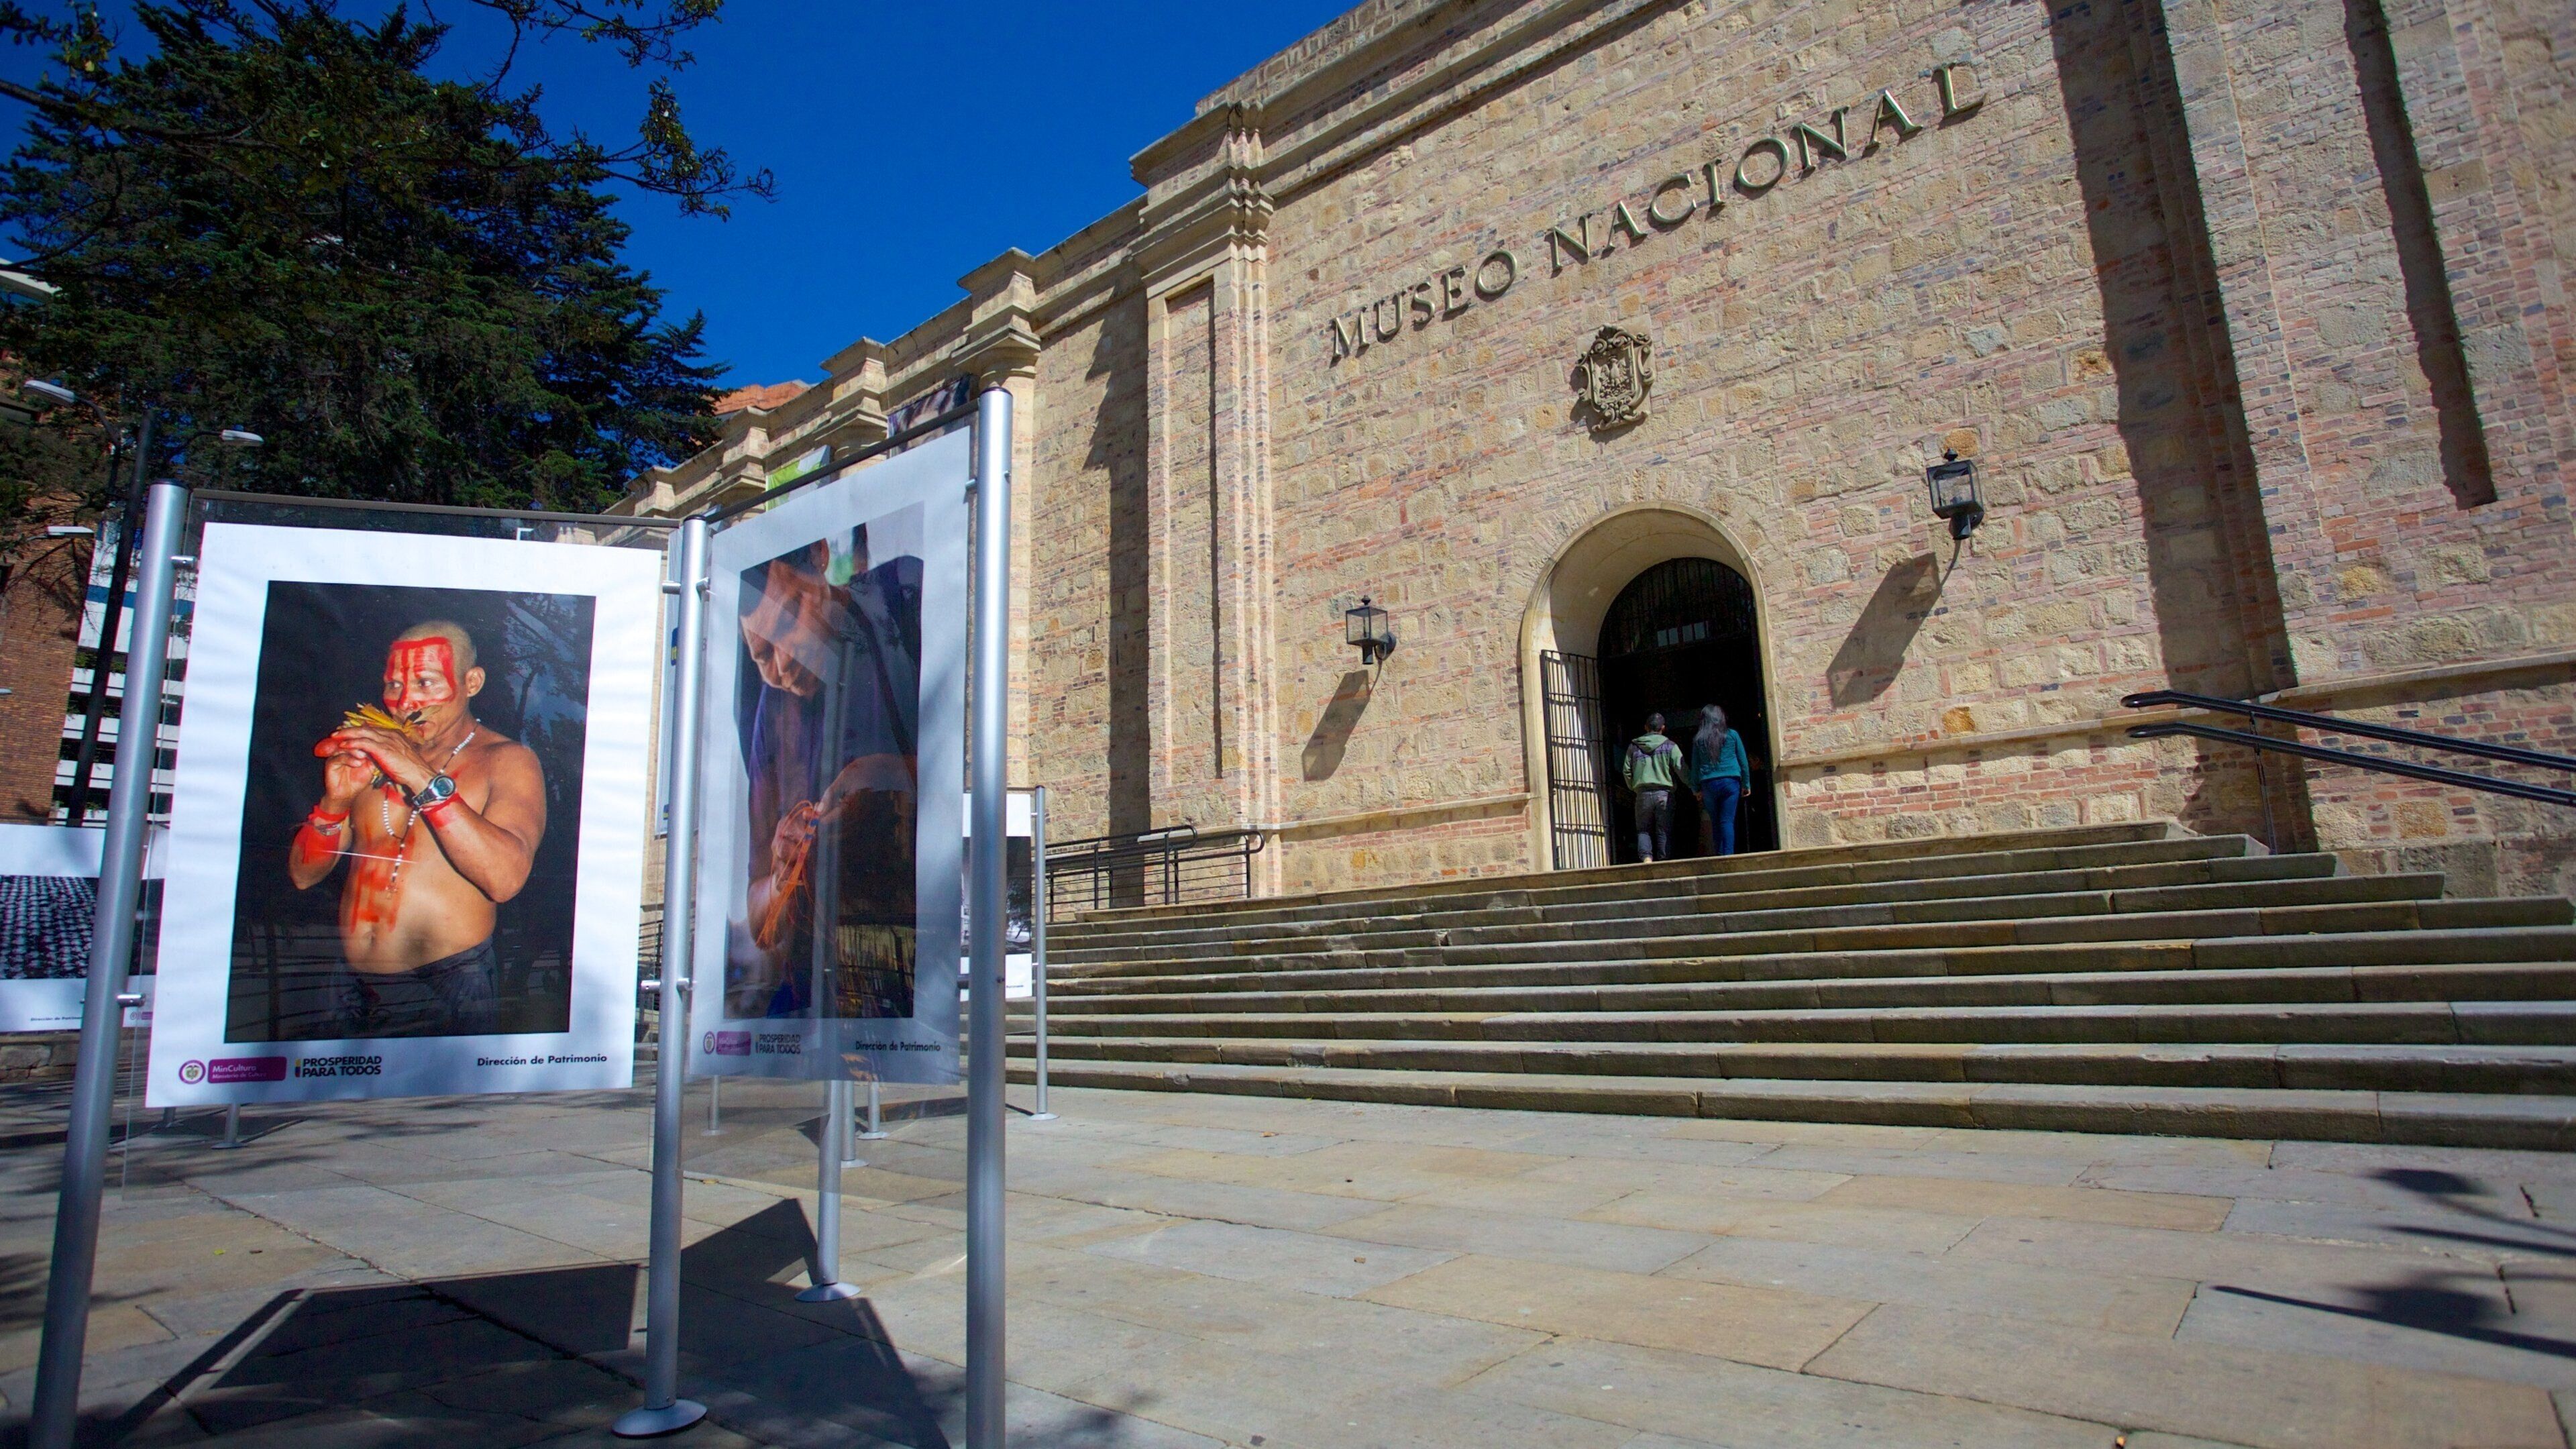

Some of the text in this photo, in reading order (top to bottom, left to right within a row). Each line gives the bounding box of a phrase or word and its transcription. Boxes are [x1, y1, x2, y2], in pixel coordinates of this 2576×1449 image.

[1332, 62, 1988, 358] MUSEO NACIONAL
[759, 1034, 801, 1043] PROSPERIDAD
[759, 1044, 801, 1055] PARA TODOS
[855, 1040, 941, 1051] Dirección de Patrimonio
[303, 1056, 382, 1067] PROSPERIDAD
[477, 1053, 608, 1067] Dirección de Patrimonio
[212, 1064, 257, 1073] MinCultura
[303, 1065, 382, 1077] PARA TODOS
